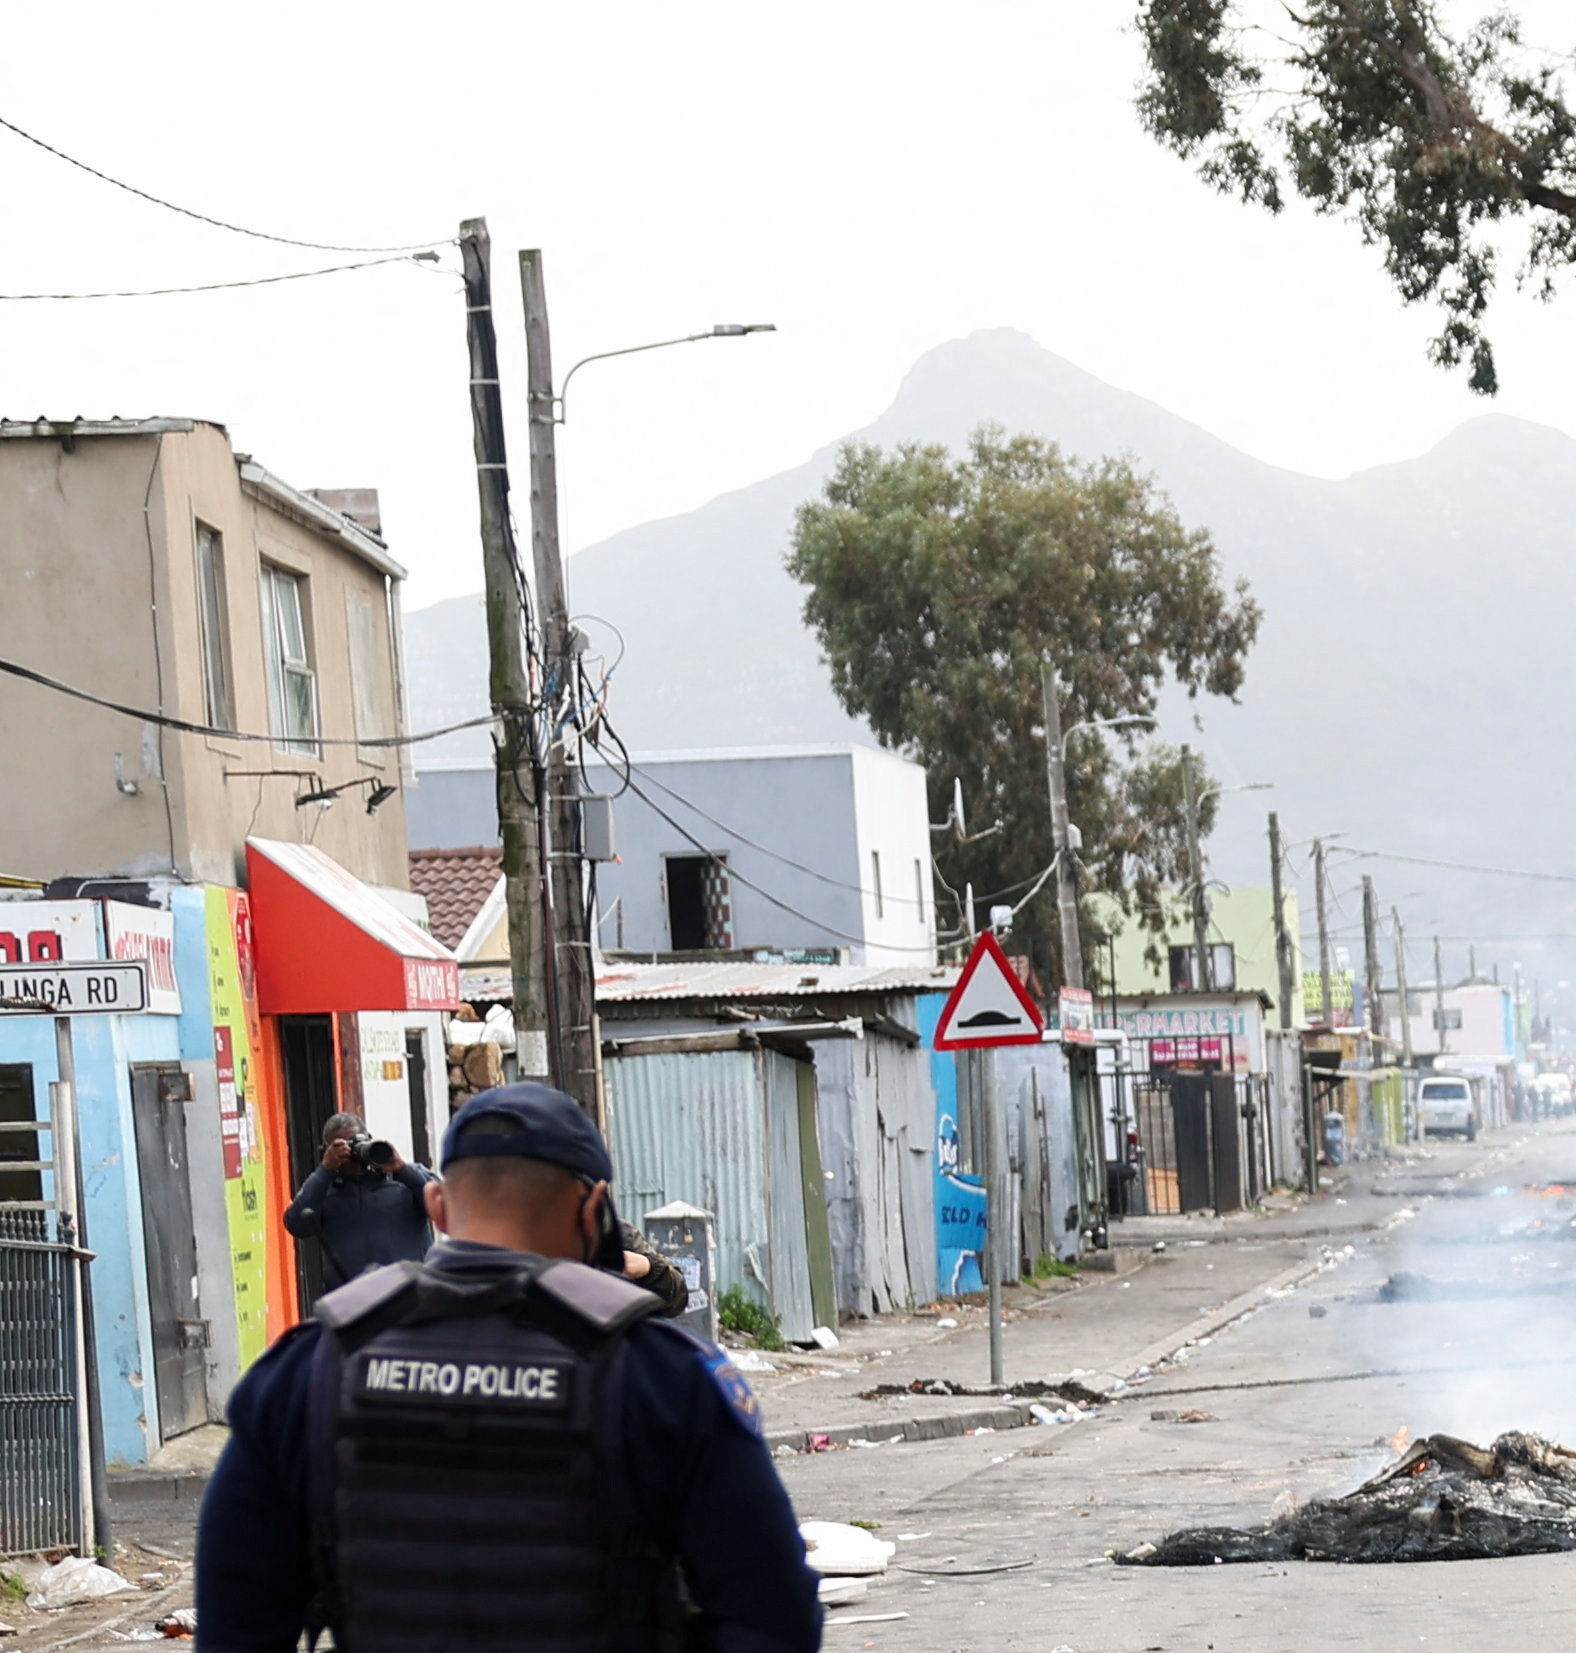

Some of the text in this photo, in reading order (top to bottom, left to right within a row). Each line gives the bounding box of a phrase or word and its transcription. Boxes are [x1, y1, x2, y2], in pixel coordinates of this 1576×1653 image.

[87, 977, 118, 1004] RD
[366, 1358, 559, 1399] METRO POLICE
